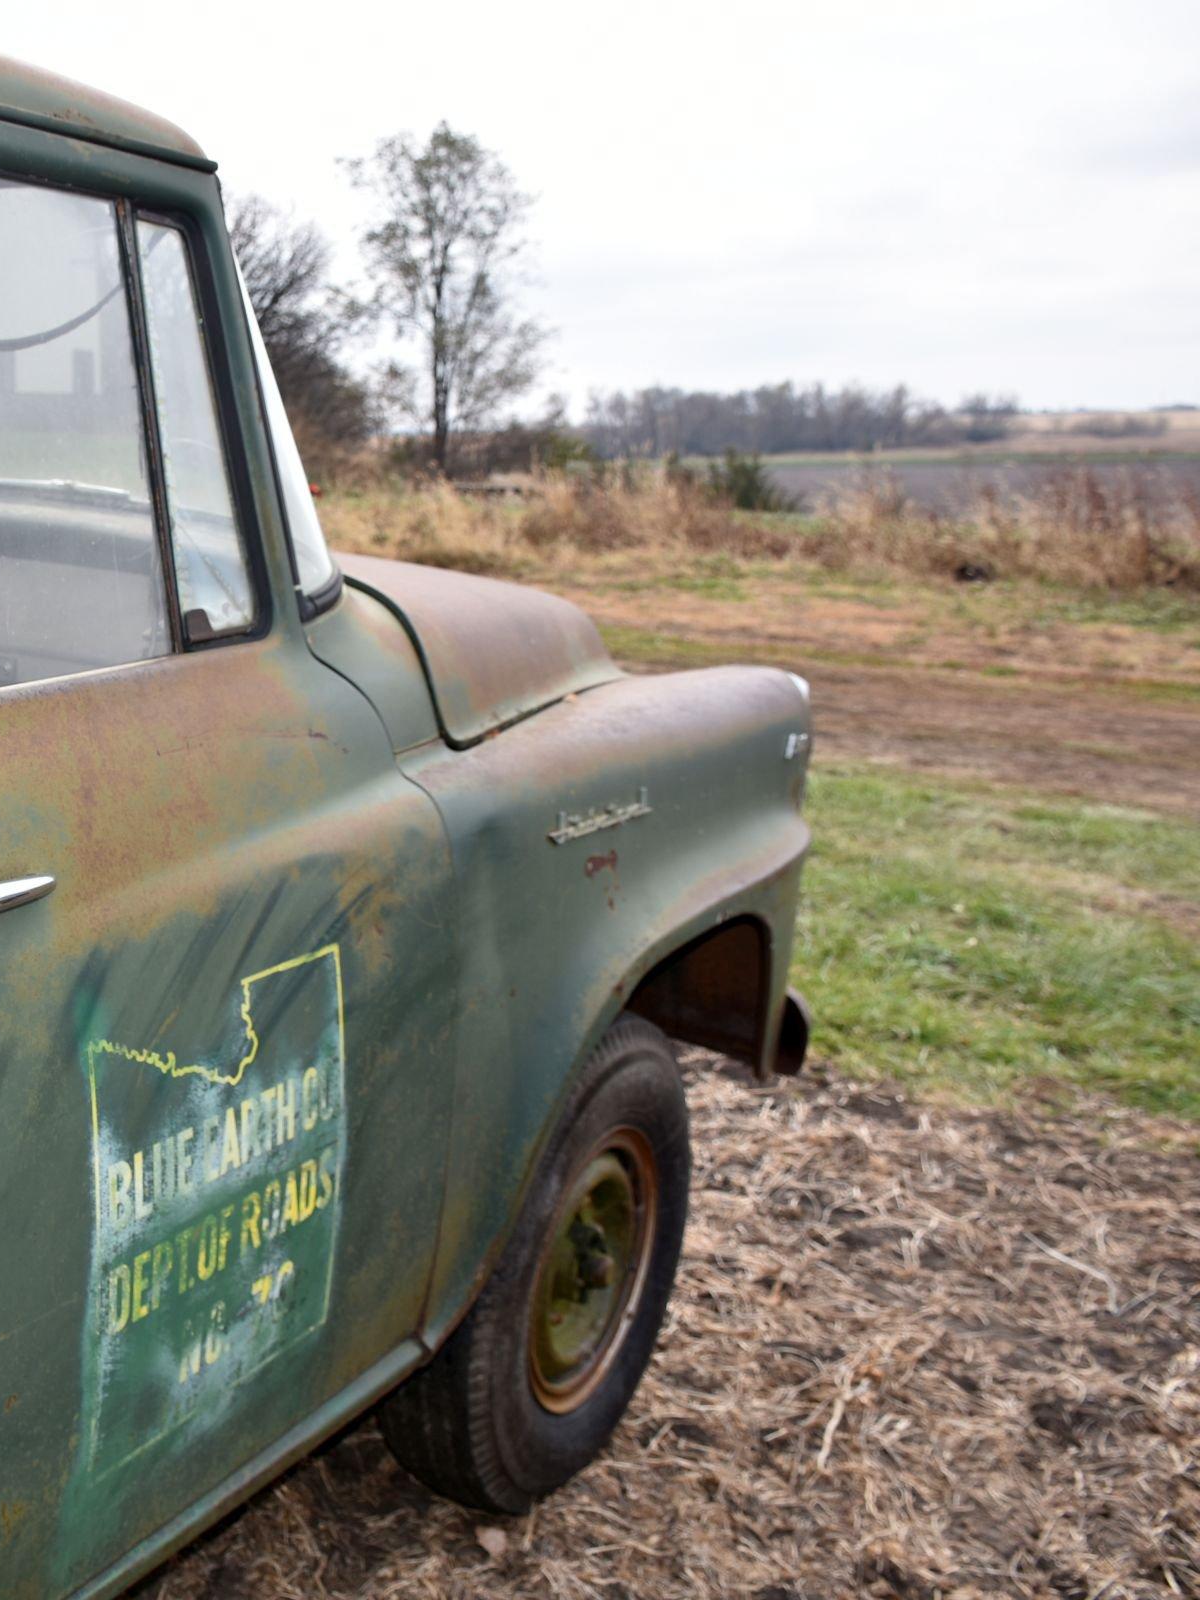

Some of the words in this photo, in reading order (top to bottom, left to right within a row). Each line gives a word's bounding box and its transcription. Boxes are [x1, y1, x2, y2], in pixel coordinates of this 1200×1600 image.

[108, 1127, 195, 1232] BLUE
[203, 1078, 296, 1184] EARTH
[198, 1204, 235, 1280] OF
[240, 1147, 334, 1258] ROADS
